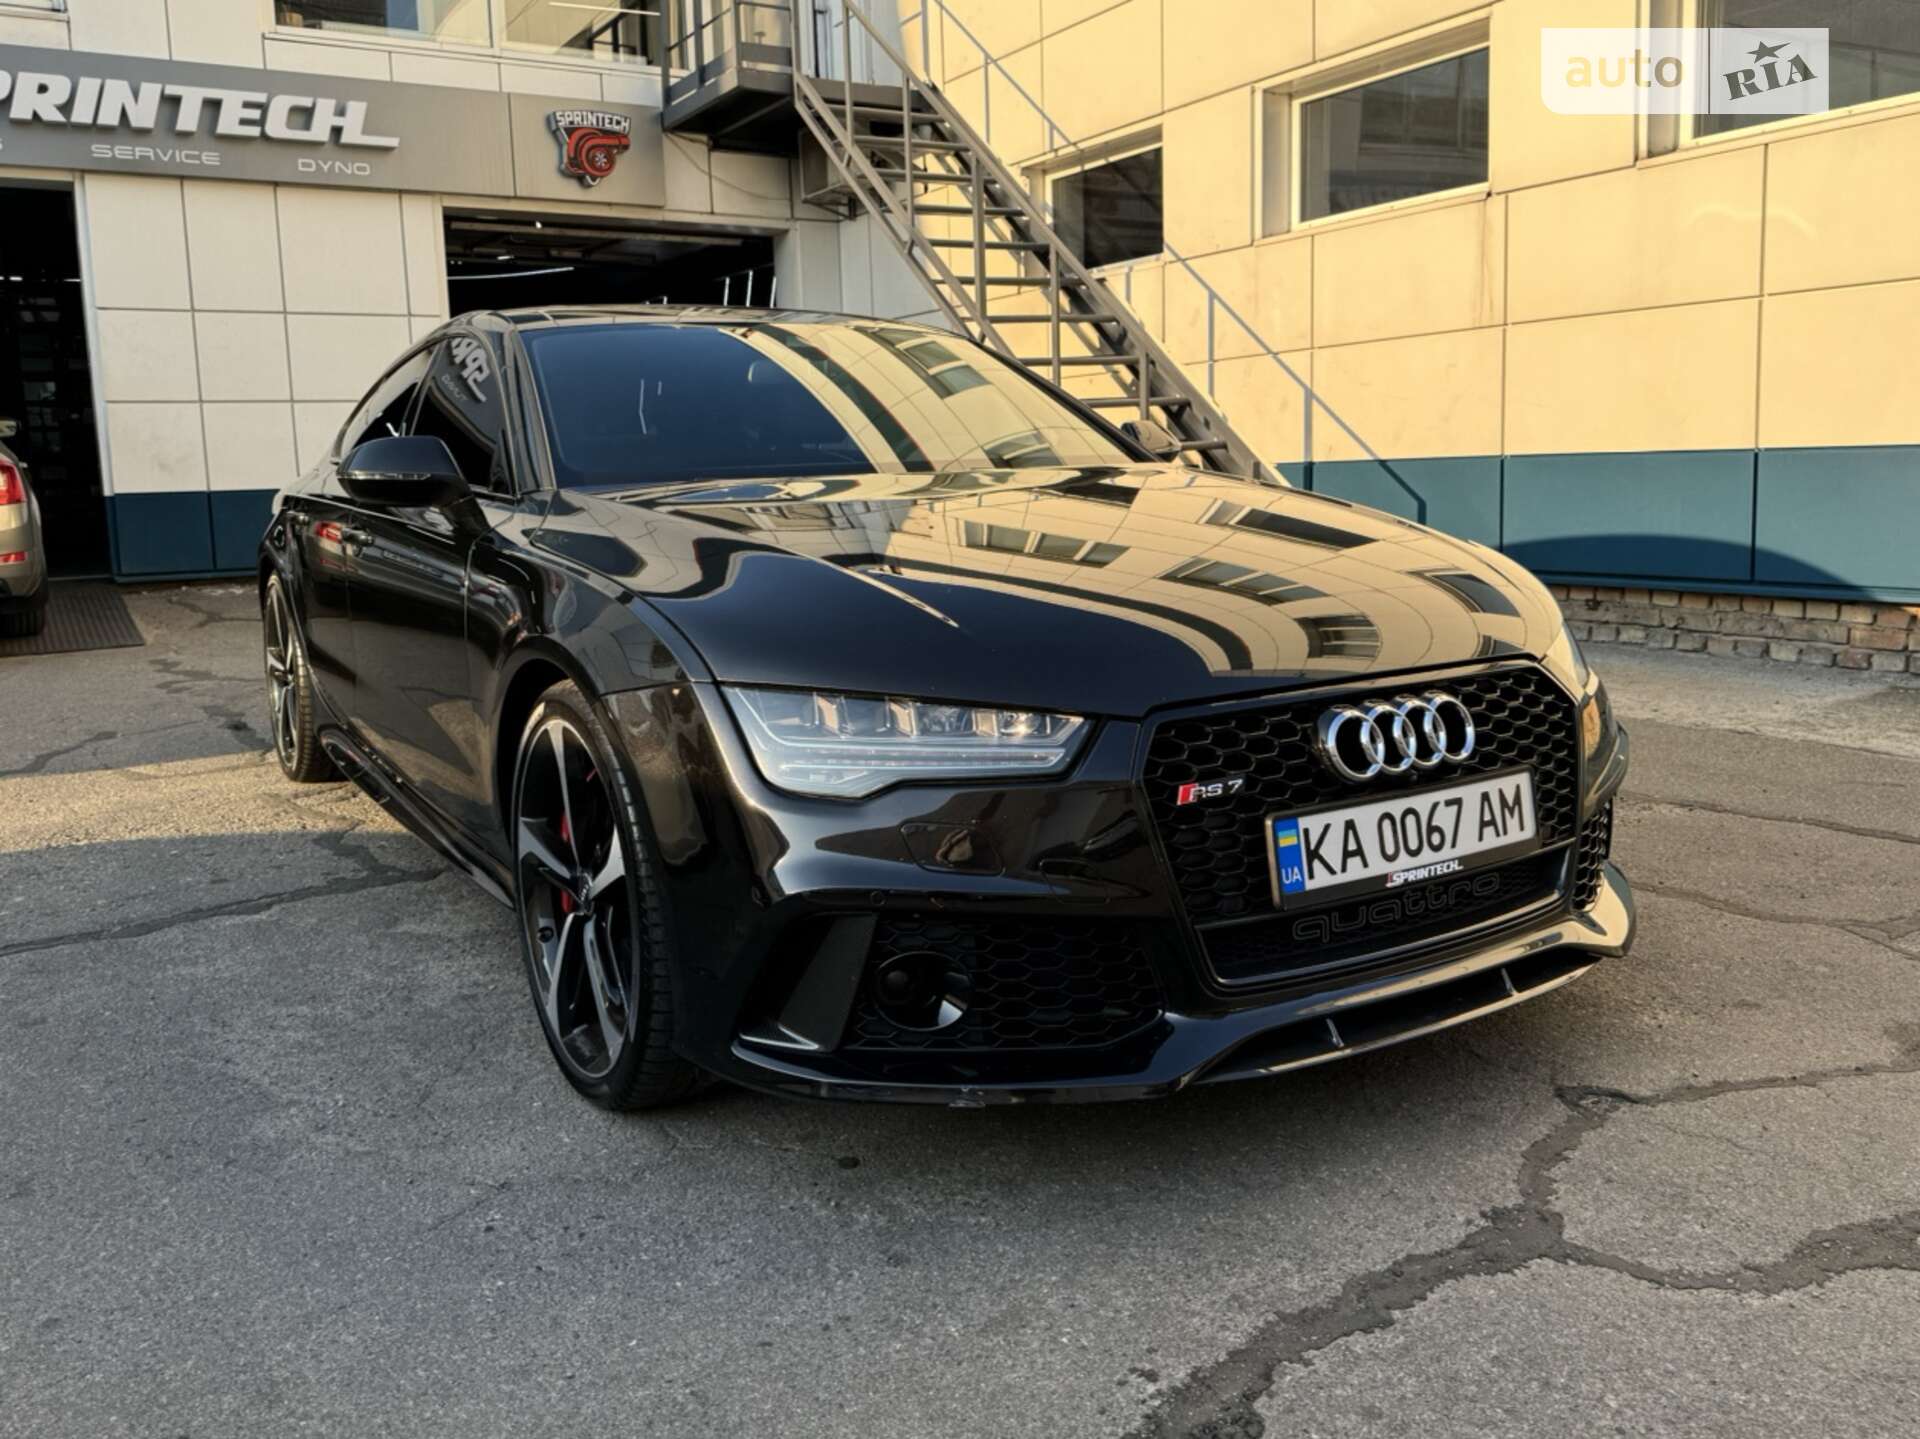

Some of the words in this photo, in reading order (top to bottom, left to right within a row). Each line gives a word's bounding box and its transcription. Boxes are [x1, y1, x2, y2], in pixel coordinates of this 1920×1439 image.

[0, 70, 400, 148] RINTECH
[556, 111, 631, 133] SPRINTECH
[91, 144, 221, 166] SERVICE
[298, 158, 371, 176] DYNO
[1303, 819, 1368, 880] KA
[1377, 797, 1463, 863] 0067
[1478, 784, 1525, 842] AM
[1282, 867, 1302, 885] UA
[1293, 872, 1501, 943] quattro
